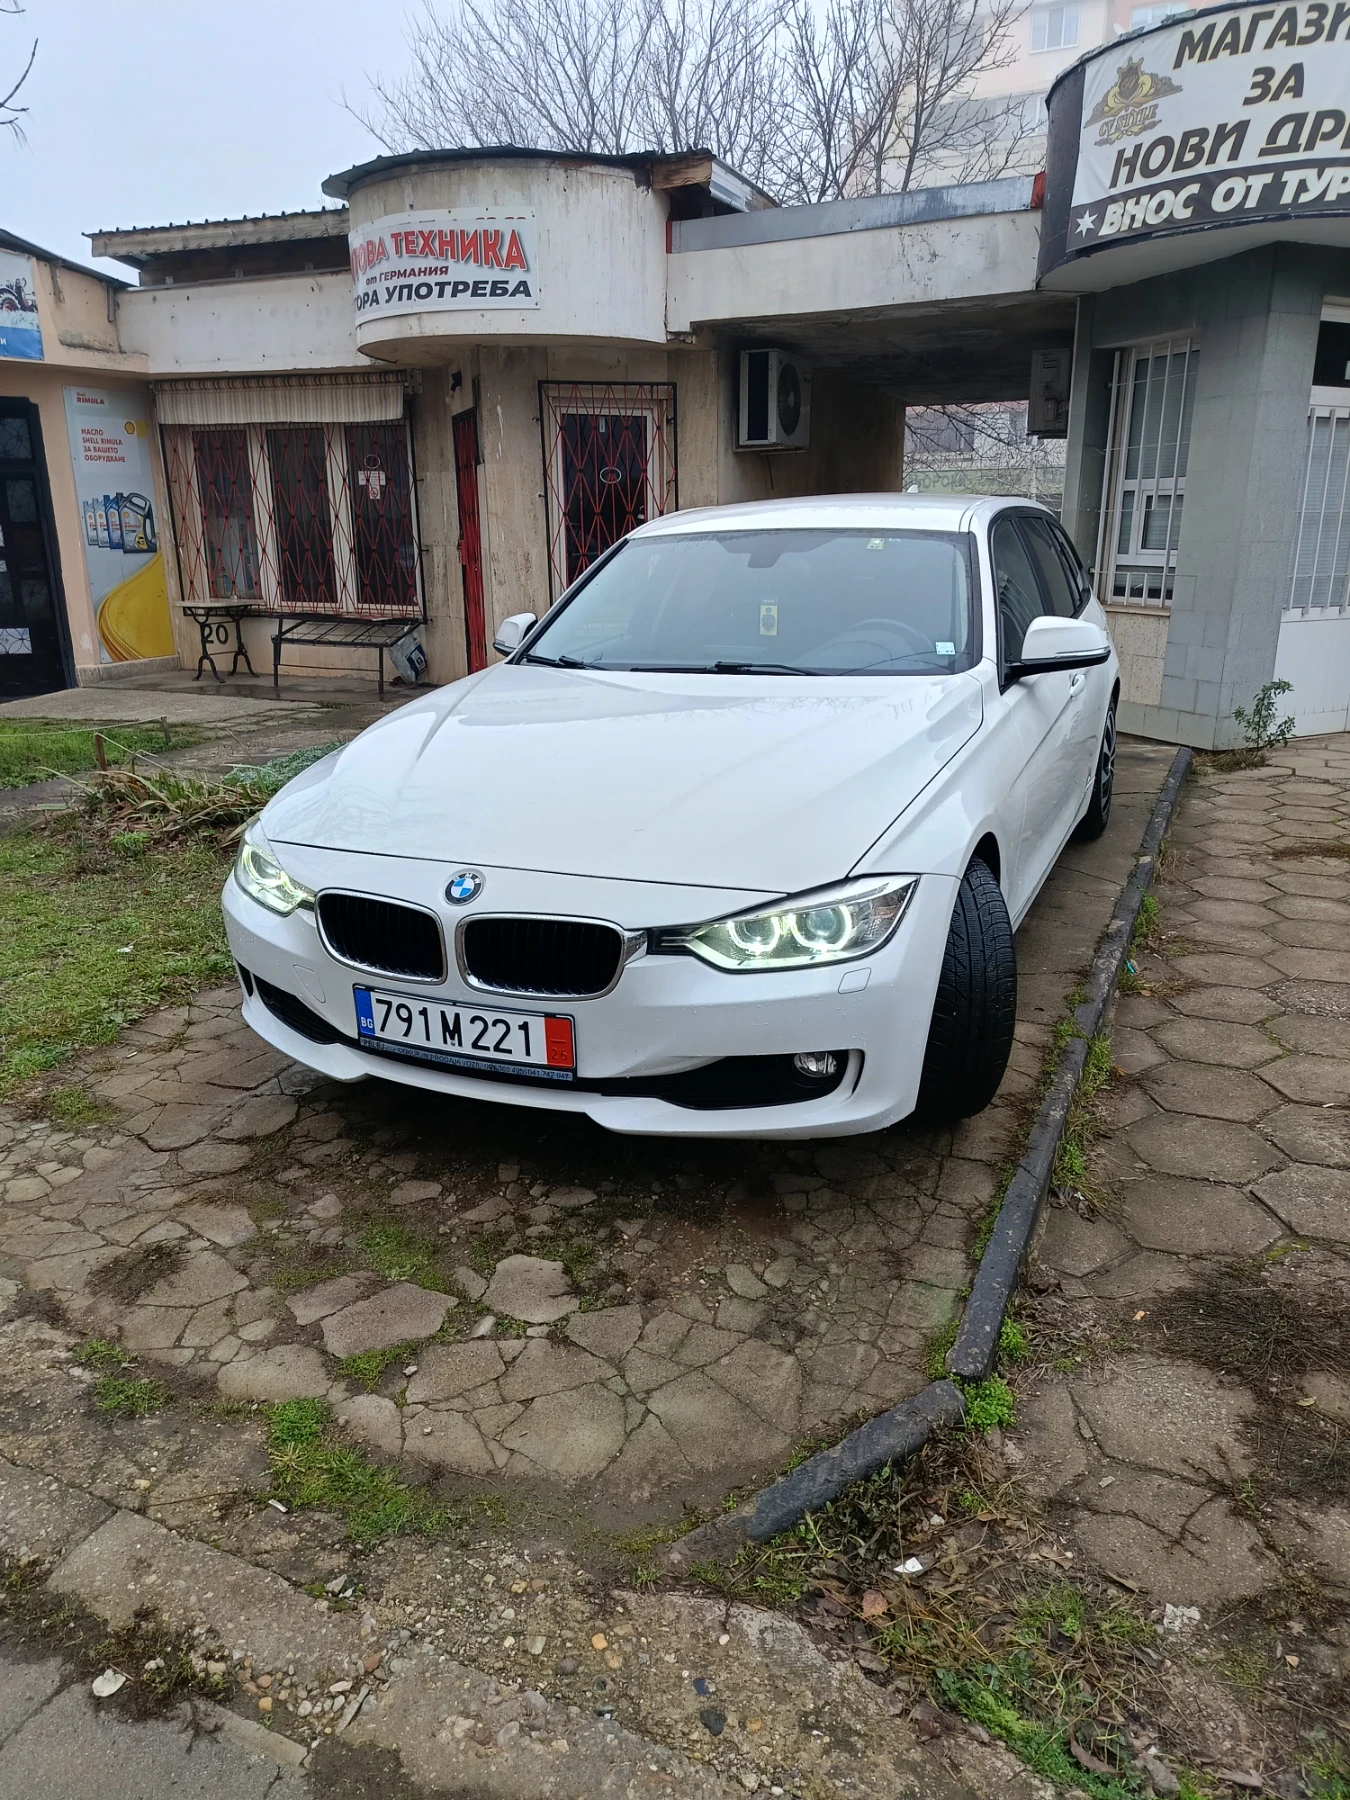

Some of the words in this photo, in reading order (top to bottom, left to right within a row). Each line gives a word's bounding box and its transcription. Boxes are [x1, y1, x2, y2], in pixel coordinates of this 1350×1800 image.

[1242, 62, 1304, 106] ЗА
[1108, 119, 1251, 190] НОВИ
[1097, 183, 1201, 236] ВНОС
[1210, 172, 1274, 213] ОТ
[391, 228, 528, 271] ТЕХНИКА
[365, 276, 377, 286] от
[379, 265, 449, 283] ГЕРМАНИЯ
[385, 280, 533, 304] УПОТРЕБА
[76, 396, 106, 406] RIMULA
[81, 427, 104, 437] МАСЛО
[82, 437, 99, 445] SHELL
[101, 438, 123, 446] RIMULA
[83, 445, 92, 453] ЗА
[93, 446, 119, 454] ВАШЕТО
[84, 454, 126, 463] ОБОРУДВАНЕ
[361, 1016, 373, 1029] BG
[551, 1047, 568, 1061] 26
